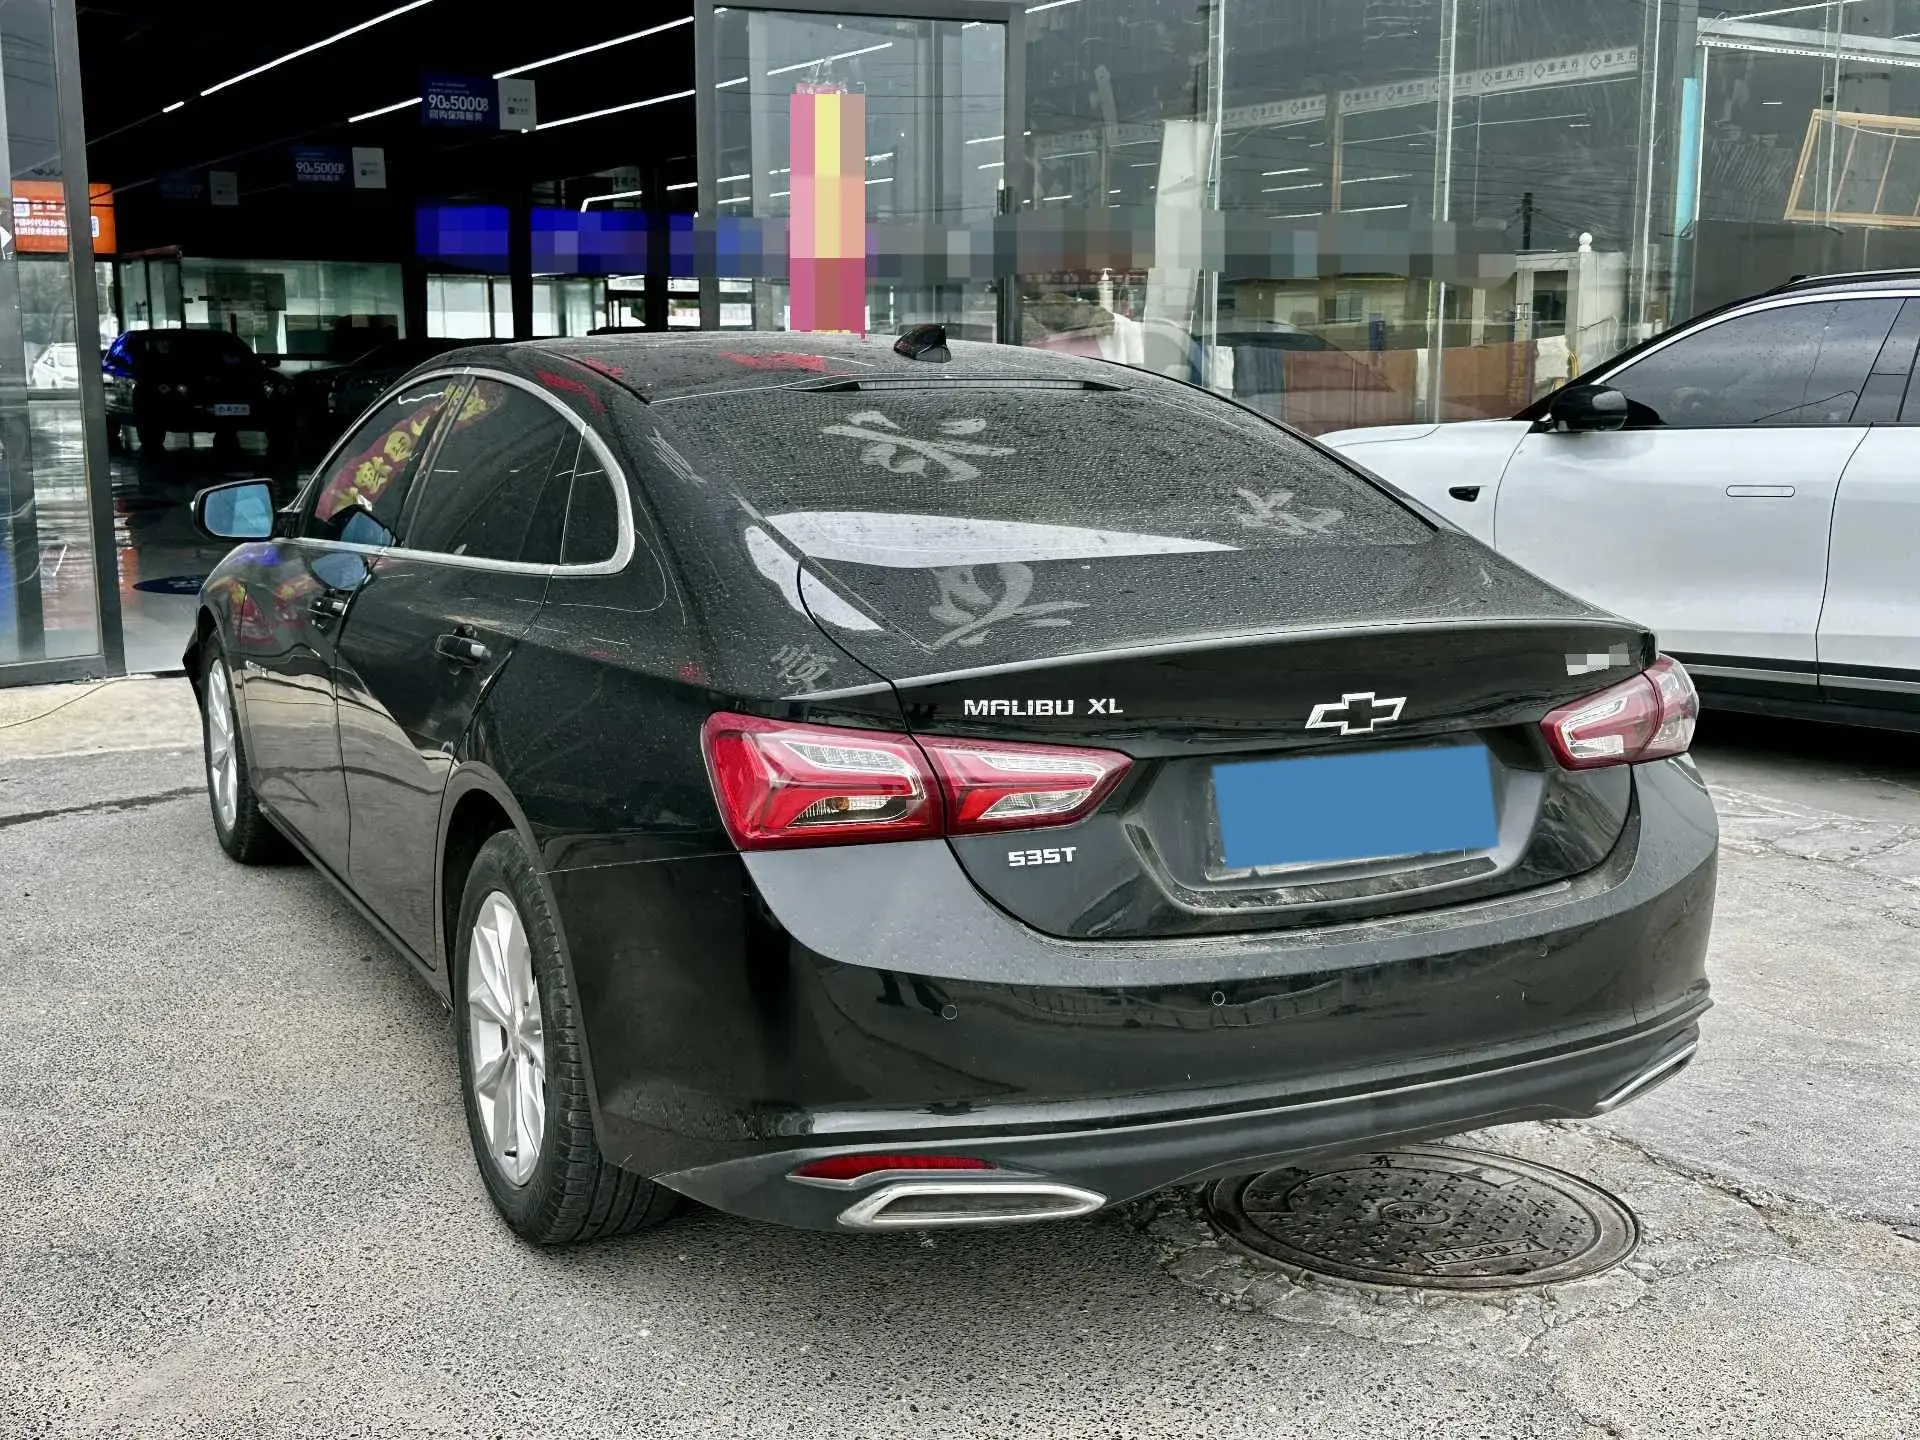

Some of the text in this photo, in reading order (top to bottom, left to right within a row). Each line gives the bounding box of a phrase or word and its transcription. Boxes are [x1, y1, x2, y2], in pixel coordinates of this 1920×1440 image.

[964, 698, 1124, 716] MALIBU XL
[1008, 846, 1077, 867] 535T
